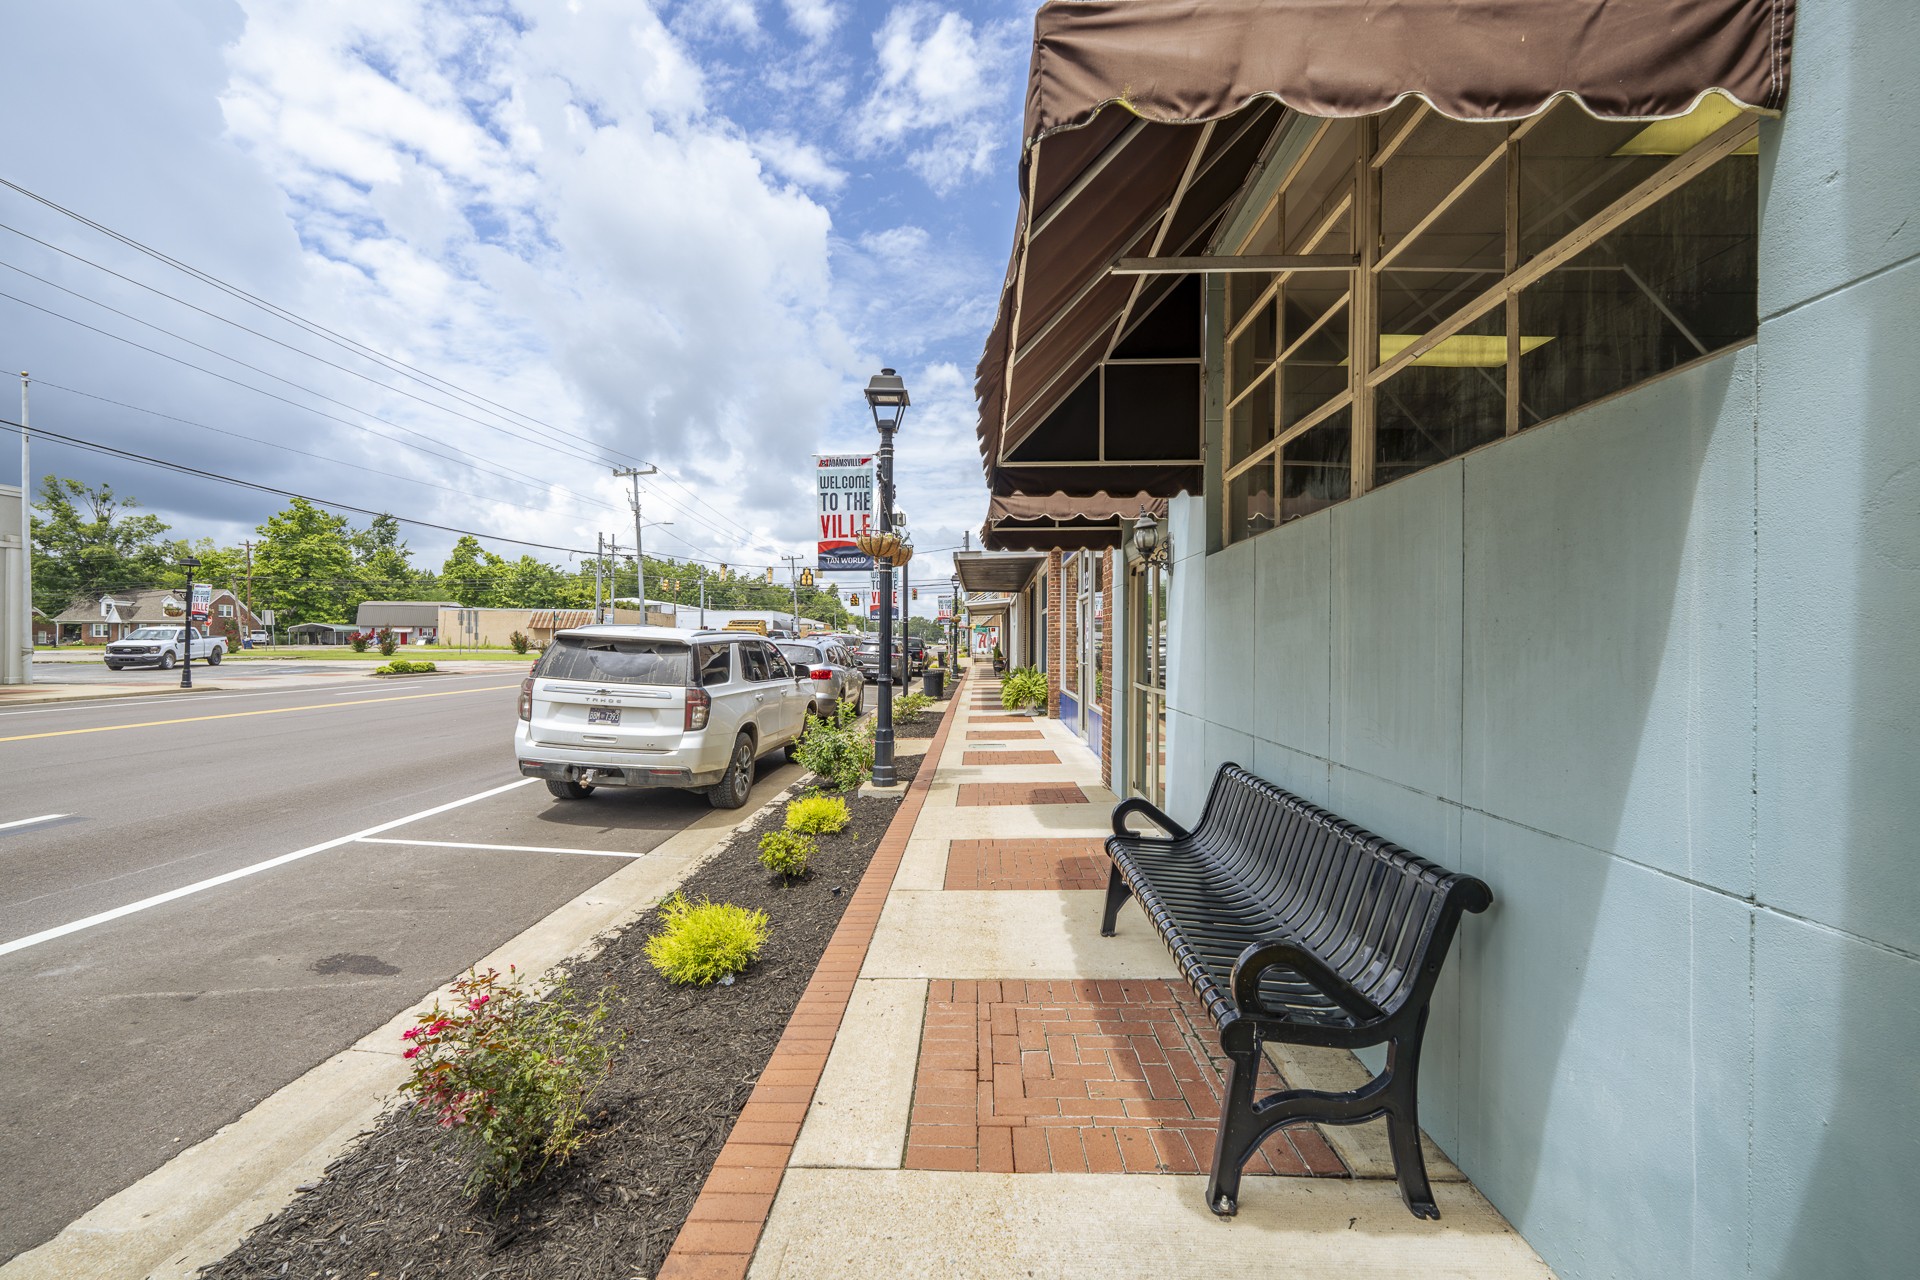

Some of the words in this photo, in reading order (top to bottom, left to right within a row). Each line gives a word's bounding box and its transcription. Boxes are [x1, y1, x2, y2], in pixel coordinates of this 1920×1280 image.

[829, 458, 861, 467] ADAMSVILLE
[820, 475, 870, 489] WELCOME
[820, 492, 838, 511] TO
[844, 491, 871, 511] THE
[820, 513, 871, 538] VILLE
[841, 556, 866, 564] WORLD
